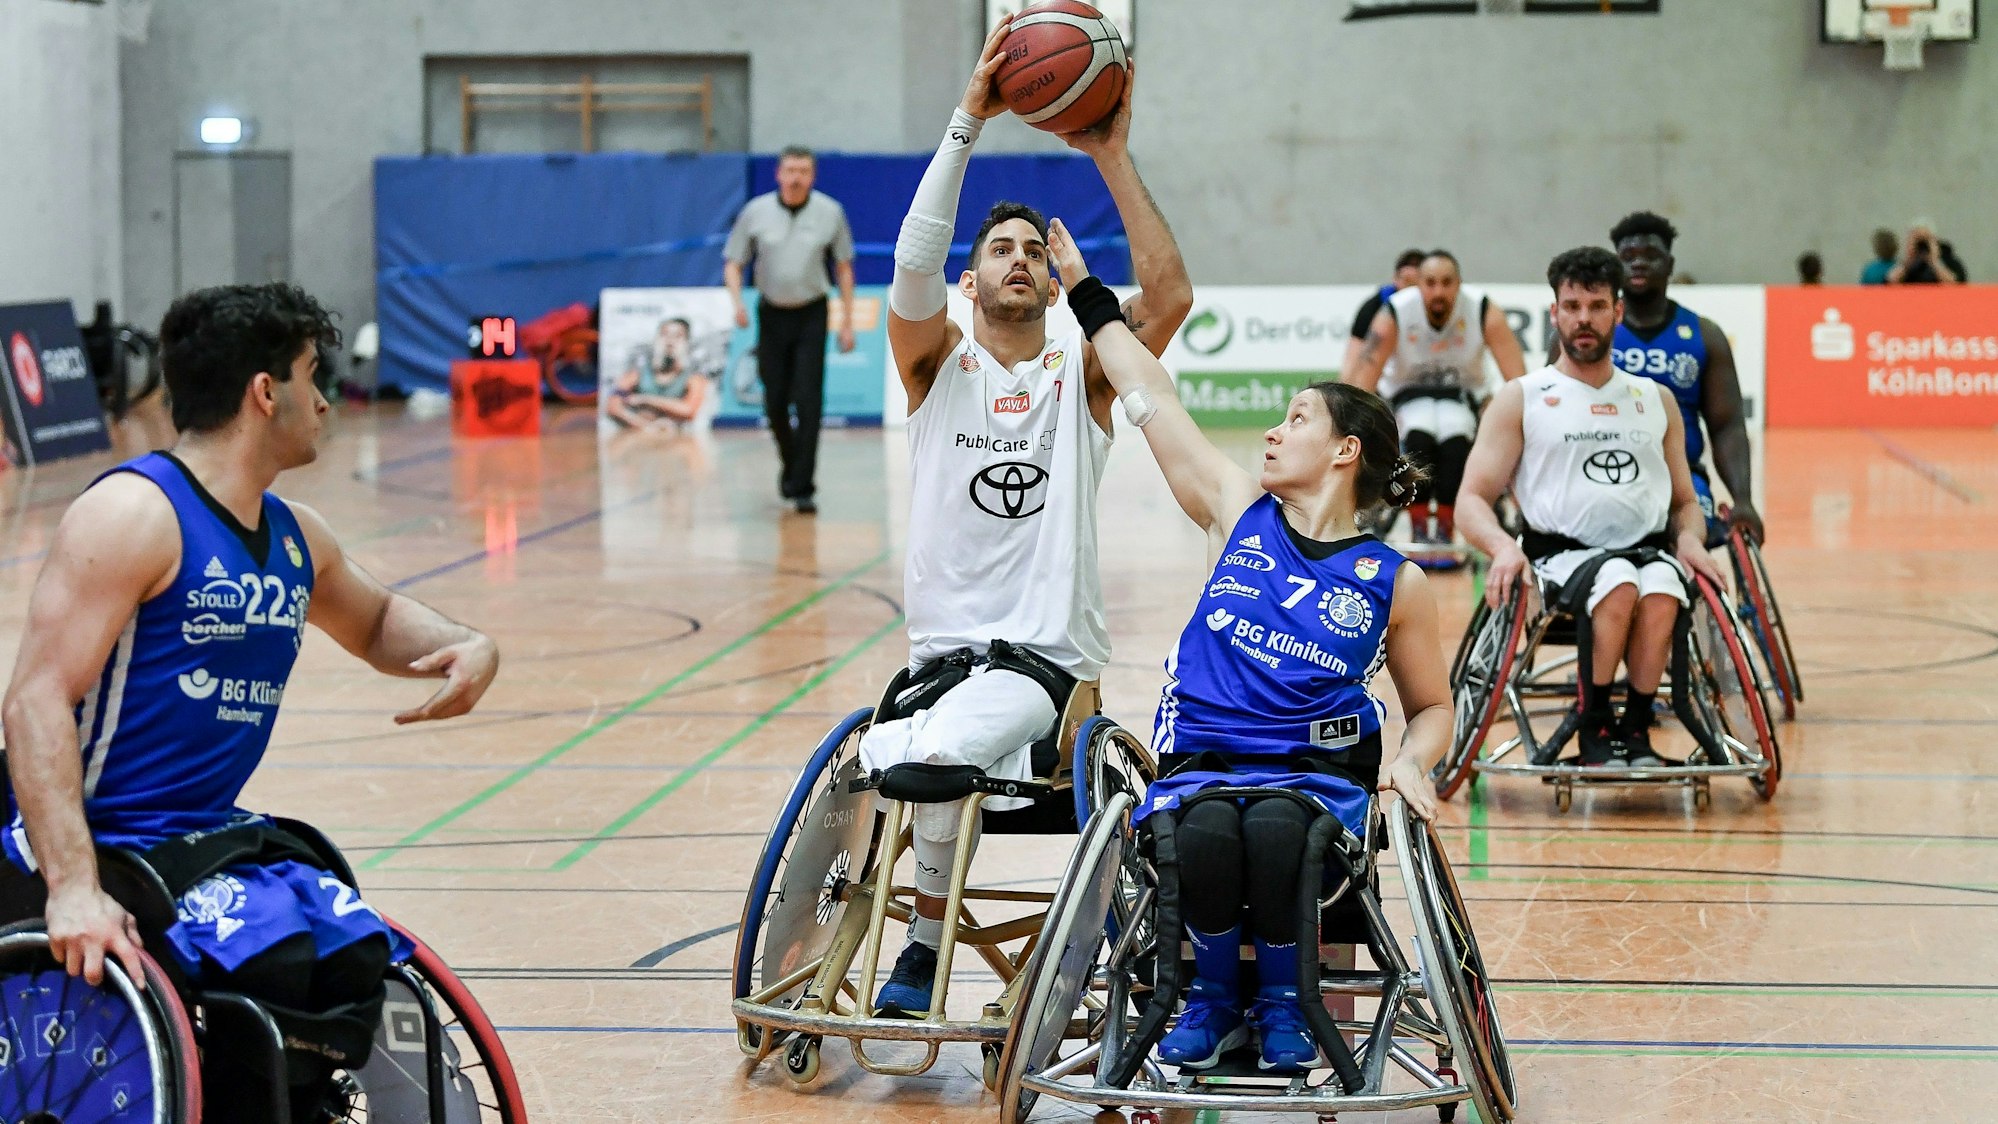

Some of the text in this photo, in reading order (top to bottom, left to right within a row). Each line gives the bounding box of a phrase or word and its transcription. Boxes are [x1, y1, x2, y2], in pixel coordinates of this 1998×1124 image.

[1010, 71, 1056, 101] molten
[483, 317, 515, 356] 14
[1625, 347, 1667, 375] 93
[1179, 378, 1284, 412] Macht
[955, 433, 1029, 453] PubliCare
[1564, 430, 1620, 442] PubliCare
[1222, 553, 1264, 571] STOLLE
[186, 589, 237, 609] STOLLE
[240, 573, 290, 627] 22
[1209, 582, 1262, 597] borchers
[1280, 574, 1317, 610] 7
[1318, 614, 1359, 638] HAMBURG
[1231, 636, 1281, 669] Hamburg
[1234, 618, 1348, 676] BG Klinikum
[221, 678, 246, 702] BG
